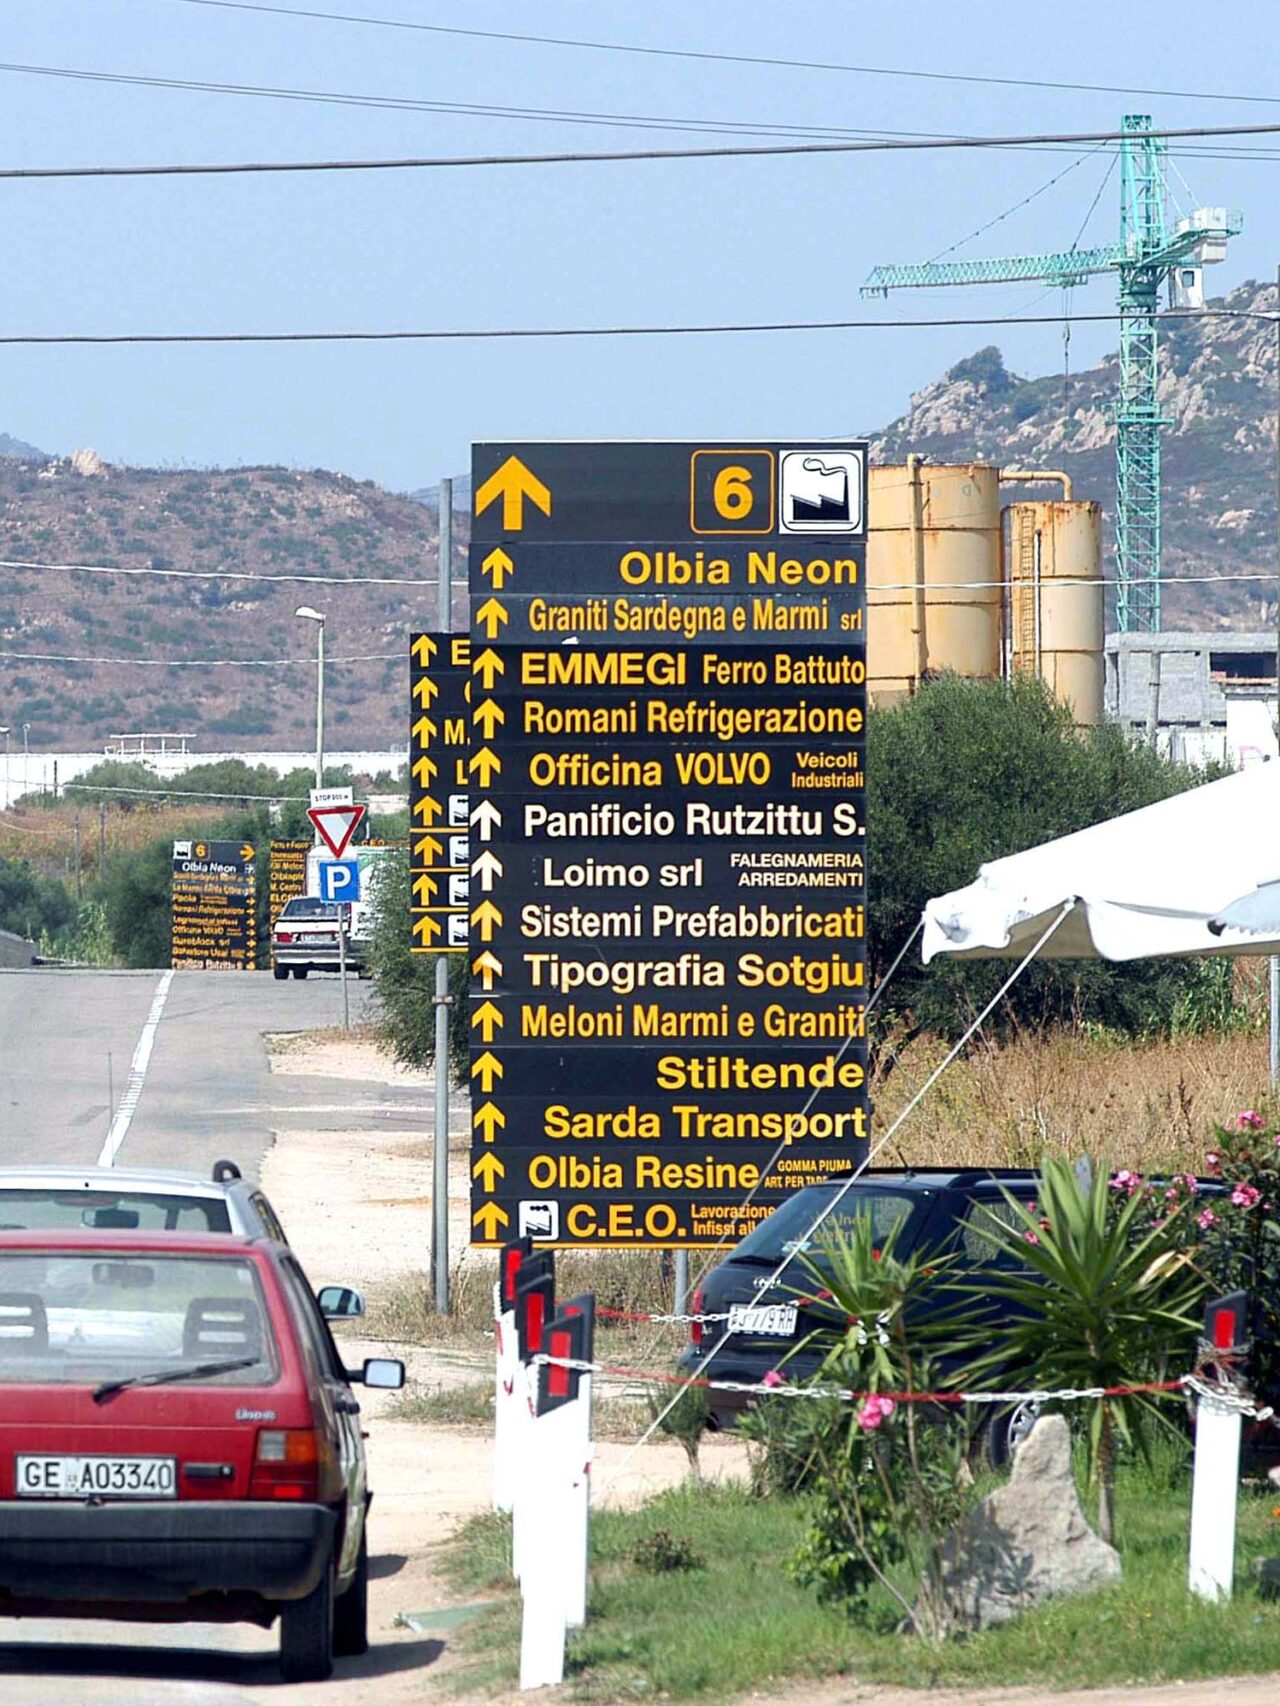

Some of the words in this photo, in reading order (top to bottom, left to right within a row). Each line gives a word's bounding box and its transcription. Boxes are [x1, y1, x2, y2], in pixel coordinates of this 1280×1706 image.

[714, 466, 753, 520] 6
[620, 552, 730, 585] Olbia
[748, 552, 857, 585] Neon
[529, 598, 608, 632] Graniti
[613, 598, 726, 639] Sardegna
[732, 606, 746, 632] e
[753, 598, 828, 631] Marmi
[840, 609, 863, 631] srl
[522, 652, 686, 686] EMMEGI
[703, 654, 767, 685] Ferro
[775, 654, 866, 685] Battuto
[524, 701, 637, 734] Romani
[647, 701, 863, 741] Refrigerazione
[529, 752, 662, 787] Officina
[675, 752, 771, 785] VOLVO
[796, 752, 858, 769] Veicoli
[791, 772, 864, 788] Industriali
[524, 804, 675, 836] Panificio
[686, 803, 822, 836] Rutzittu
[832, 803, 866, 836] S.
[181, 861, 209, 873] Olbia
[209, 861, 237, 873] Neon
[195, 844, 206, 858] 6
[730, 853, 864, 868] FALEGNAMERIA
[326, 865, 352, 900] P
[543, 858, 649, 887] Loimo
[659, 858, 703, 887] srl
[738, 872, 863, 887] ARREDAMENTI
[521, 905, 641, 938] Sistemi
[652, 905, 864, 938] Prefabbricati
[523, 954, 725, 993] Tipografia
[737, 954, 864, 993] Sotgiu
[521, 1004, 623, 1037] Meloni
[633, 1004, 728, 1037] Marmi
[737, 1012, 755, 1037] e
[763, 1004, 866, 1037] Graniti
[656, 1057, 865, 1089] Stiltende
[544, 1105, 661, 1138] Sarda
[672, 1106, 867, 1145] Transport
[528, 1155, 623, 1189] Olbia
[636, 1155, 760, 1189] Resine
[777, 1160, 817, 1172] GOMMA
[818, 1159, 852, 1172] PIUMA
[785, 1176, 805, 1188] PER
[566, 1204, 687, 1238] C.E.O.
[691, 1204, 777, 1219] Lavorazione
[693, 1221, 735, 1236] Infissi
[25, 1461, 61, 1488] GE
[80, 1462, 172, 1490] A03340
